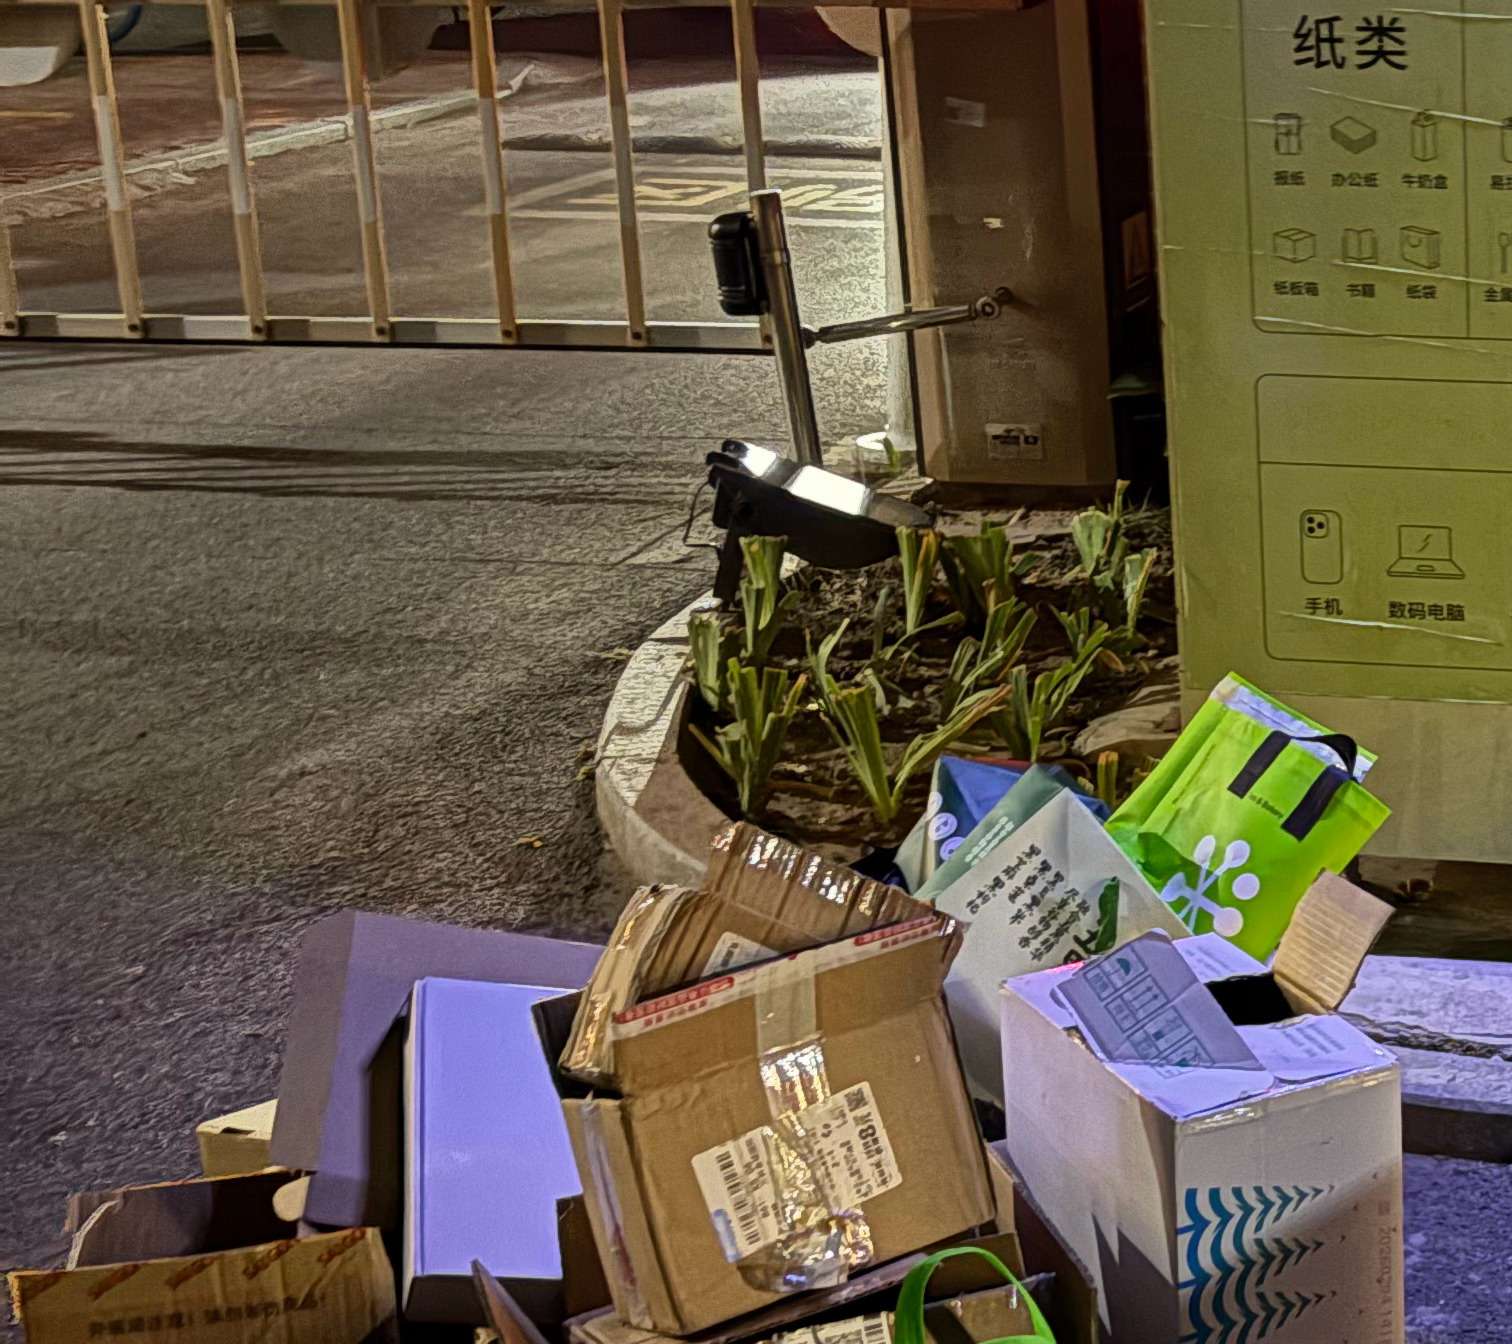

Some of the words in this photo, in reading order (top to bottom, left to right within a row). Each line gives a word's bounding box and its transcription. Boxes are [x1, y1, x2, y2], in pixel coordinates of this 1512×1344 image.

[1292, 14, 1409, 72] 纸类
[1304, 596, 1344, 617] 手机
[1388, 600, 1466, 623] 数码电脑
